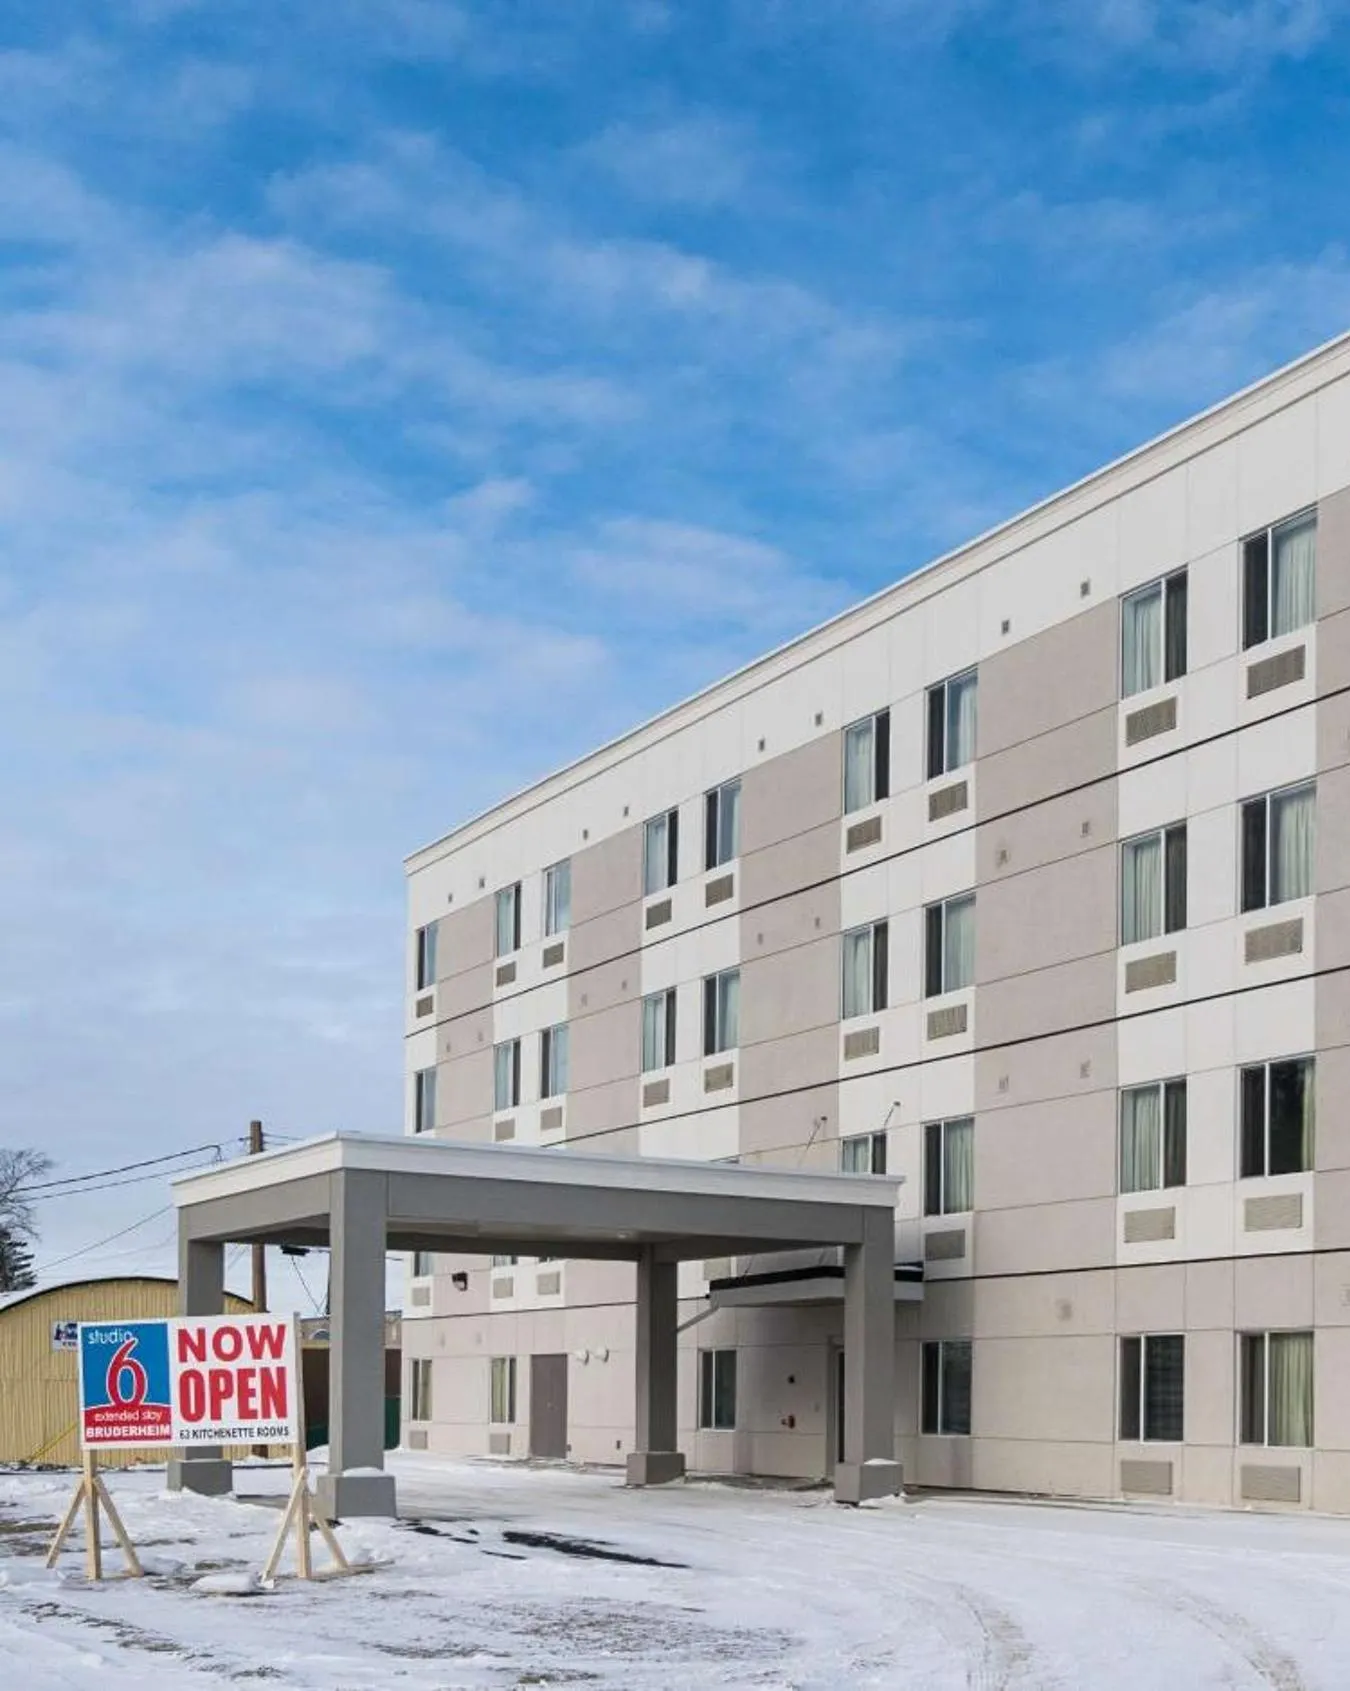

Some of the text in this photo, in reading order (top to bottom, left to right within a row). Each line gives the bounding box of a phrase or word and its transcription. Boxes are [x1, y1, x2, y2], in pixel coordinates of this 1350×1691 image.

[88, 1328, 133, 1345] studio
[178, 1324, 287, 1363] NOW
[106, 1337, 148, 1404] 6
[179, 1366, 288, 1422] OPEN
[94, 1410, 162, 1422] extended stay
[86, 1424, 170, 1438] BRUDERHEIM
[192, 1427, 254, 1439] KITCHENETTE
[257, 1425, 289, 1437] ROOMS
